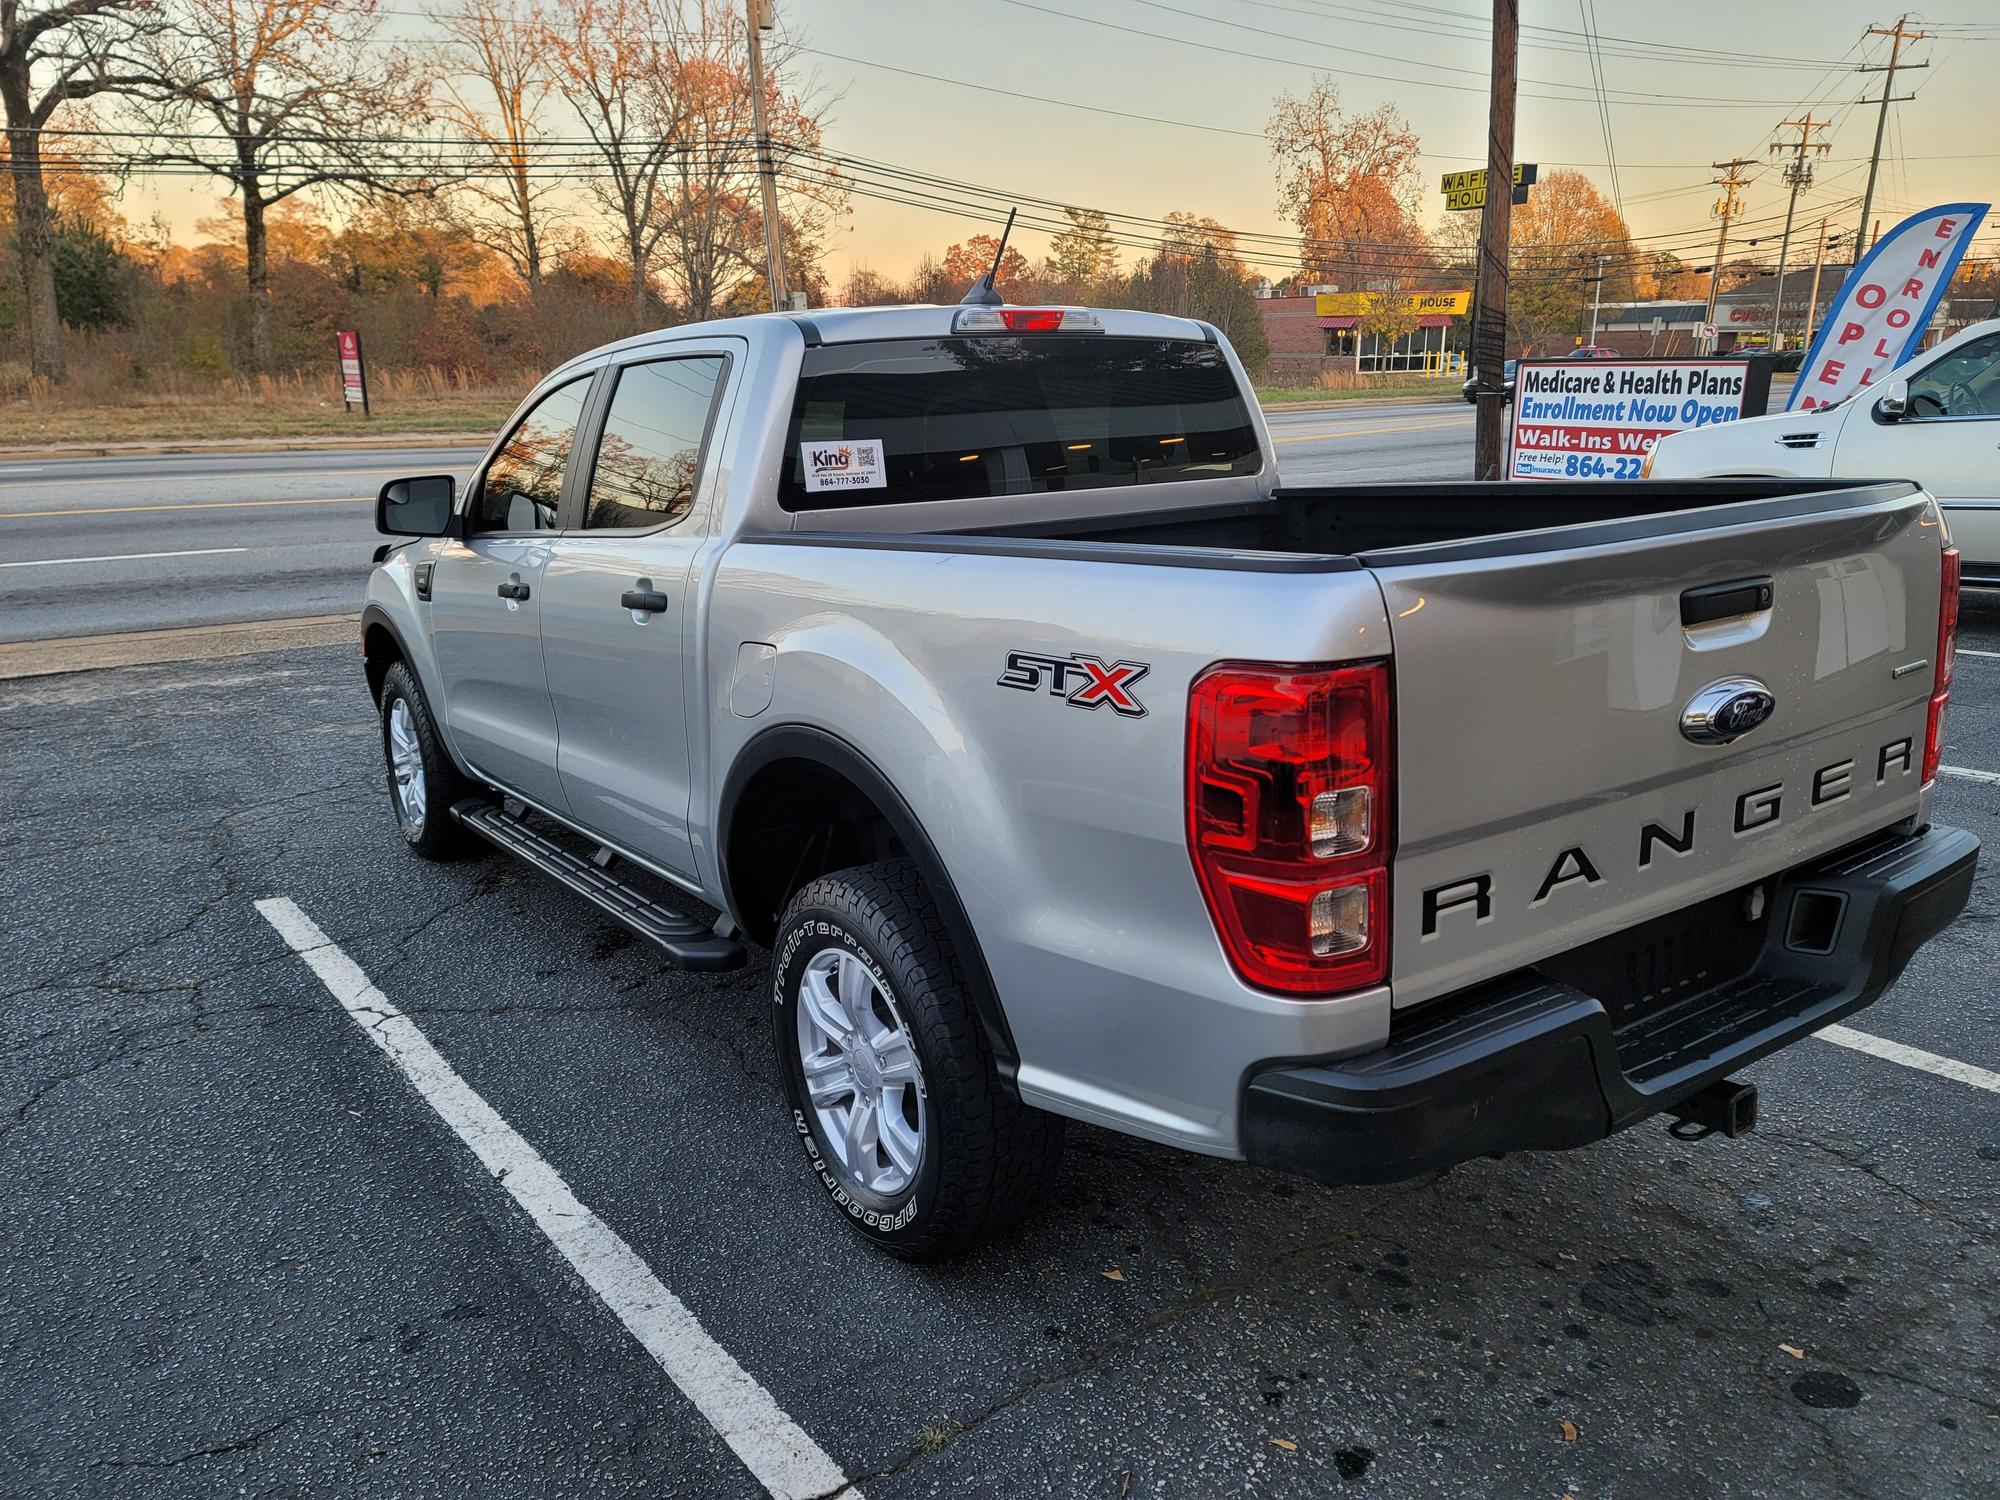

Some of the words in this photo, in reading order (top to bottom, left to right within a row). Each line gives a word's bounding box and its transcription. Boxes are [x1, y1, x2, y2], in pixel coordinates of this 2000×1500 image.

[1443, 167, 1520, 190] WAFFE
[1448, 190, 1484, 208] HOU
[1420, 297, 1456, 308] HOUSE
[1847, 218, 1957, 401] ENROLL
[1524, 371, 1599, 394] Medicare
[1603, 374, 1615, 394] &
[1619, 370, 1684, 395] Health
[1688, 370, 1742, 396] Plans
[1521, 397, 1625, 422] Enrollment
[1628, 399, 1677, 422] Now
[1681, 399, 1738, 428] Open
[1518, 428, 1612, 449] Walk-Ins
[812, 449, 849, 472] King
[1518, 452, 1537, 462] Free
[1540, 453, 1565, 465] Help!
[1532, 465, 1562, 475] Insurance
[820, 476, 869, 486] 864-777-3030
[997, 649, 1150, 719] STX
[1730, 697, 1768, 729] Ford
[1421, 736, 1913, 937] RANGER
[774, 920, 896, 1005] Trail-Terrain
[794, 1109, 917, 1231] BFGoodrich
